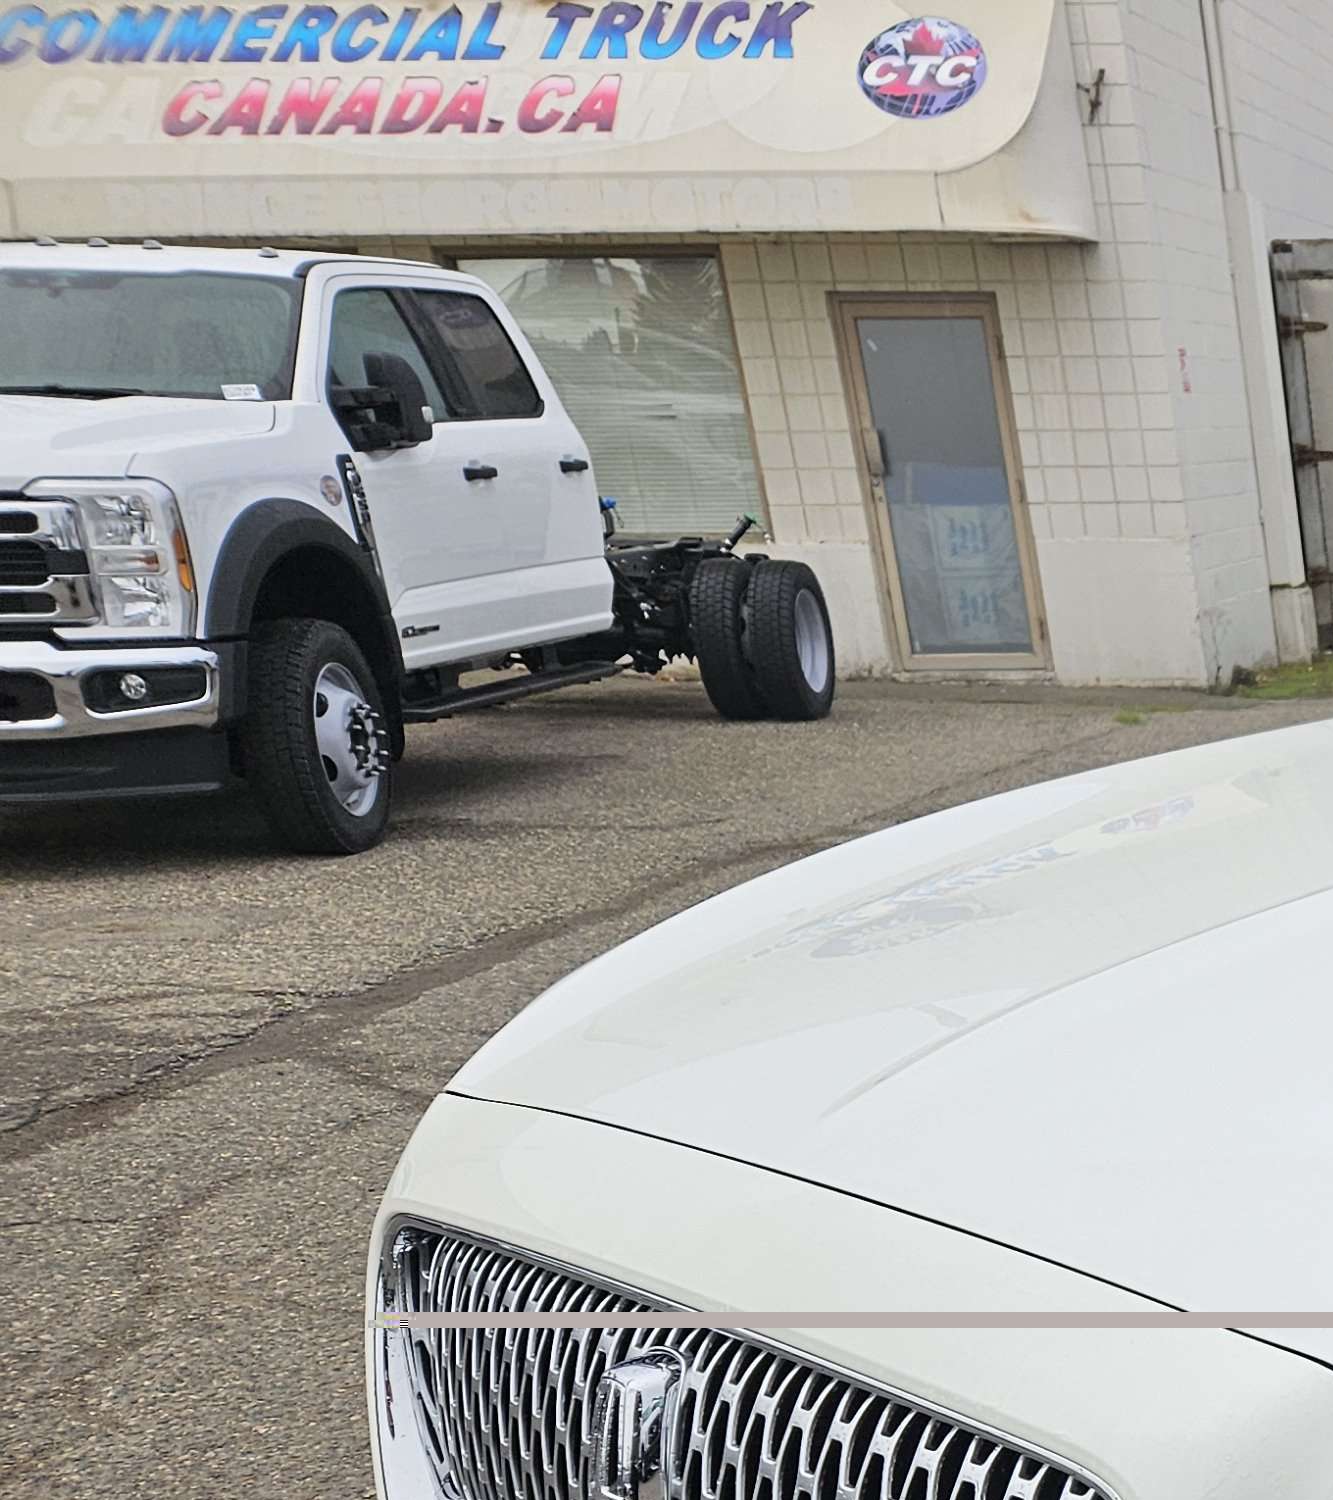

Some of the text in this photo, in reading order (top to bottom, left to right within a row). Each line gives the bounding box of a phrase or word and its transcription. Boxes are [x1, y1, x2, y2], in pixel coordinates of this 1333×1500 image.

[0, 1, 814, 64] COMMERCIAL TRUCK
[863, 55, 977, 87] CTC
[161, 73, 623, 137] CANADA.CA
